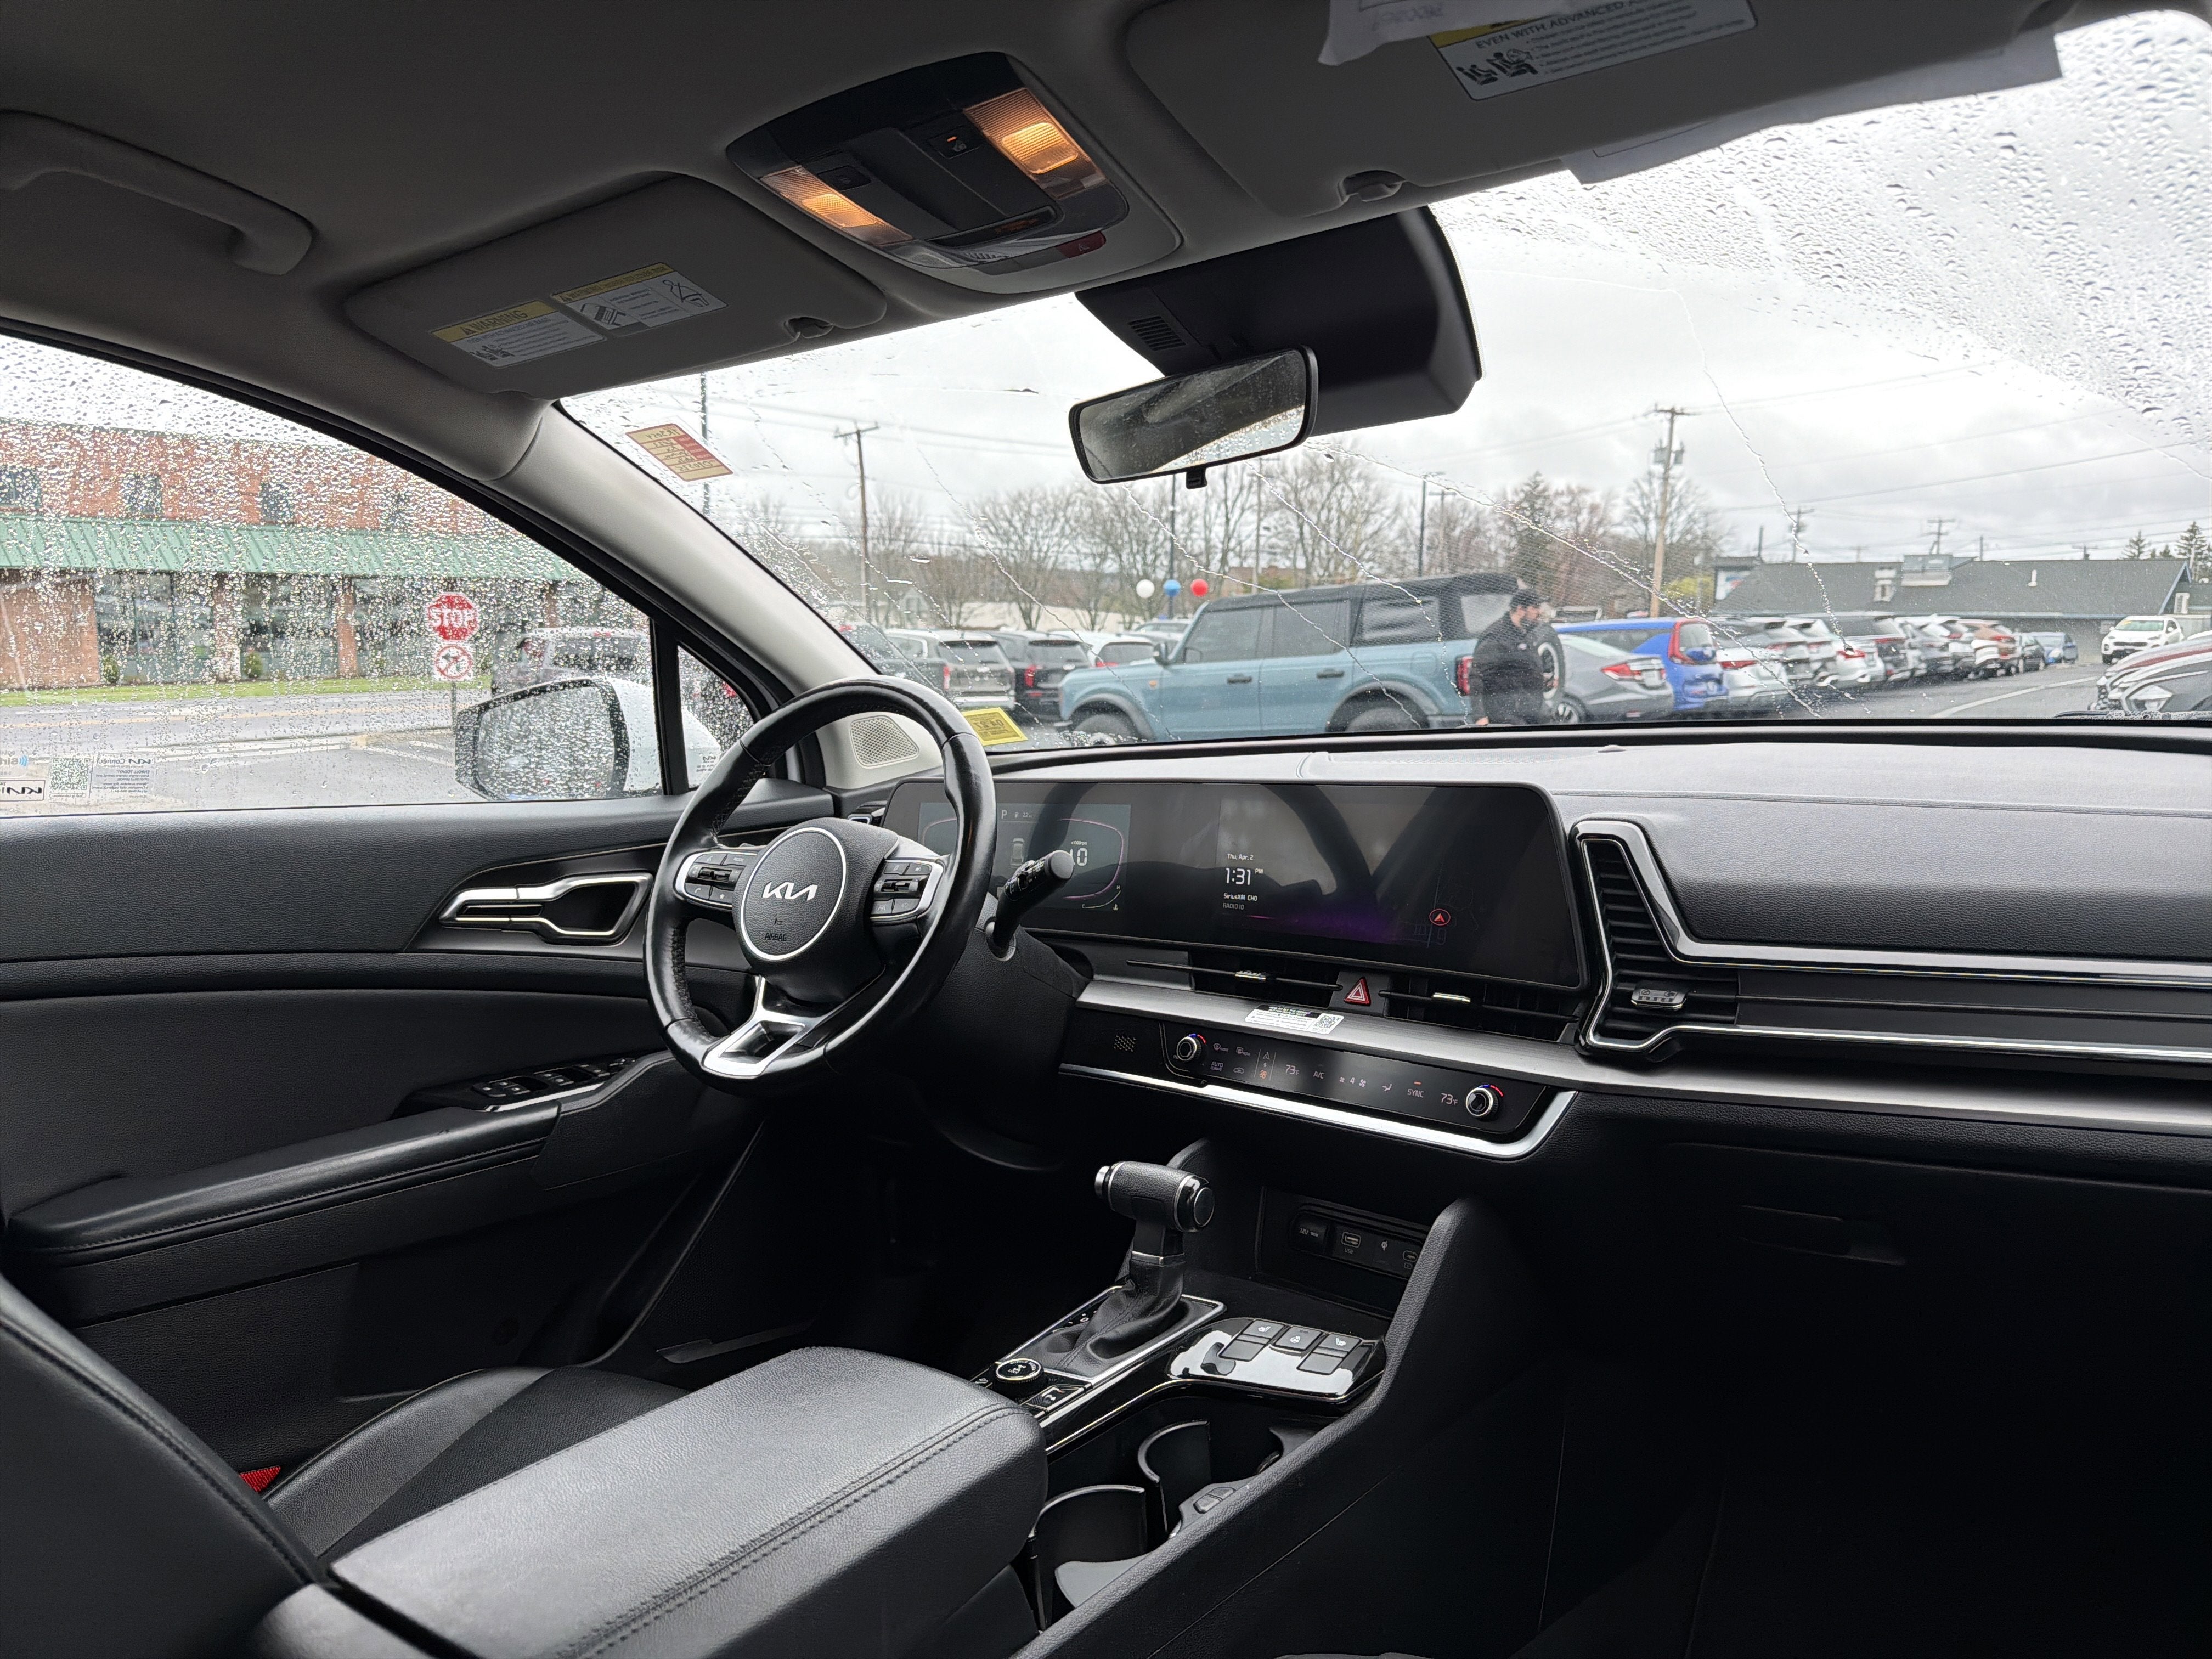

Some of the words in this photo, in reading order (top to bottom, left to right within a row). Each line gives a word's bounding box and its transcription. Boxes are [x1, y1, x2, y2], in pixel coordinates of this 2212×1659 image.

[1475, 34, 1510, 49] EVEN
[1511, 23, 1546, 38] WITH
[1549, 1, 1624, 29] ADVANCED
[471, 310, 528, 333] WARNING
[429, 607, 476, 629] STOP
[1001, 810, 1007, 819] P
[1226, 867, 1251, 885] 1:31
[761, 881, 818, 901] KIA
[764, 932, 787, 941] AIRBAG
[1313, 1071, 1325, 1079] A/C
[1407, 1088, 1425, 1098] SYNC
